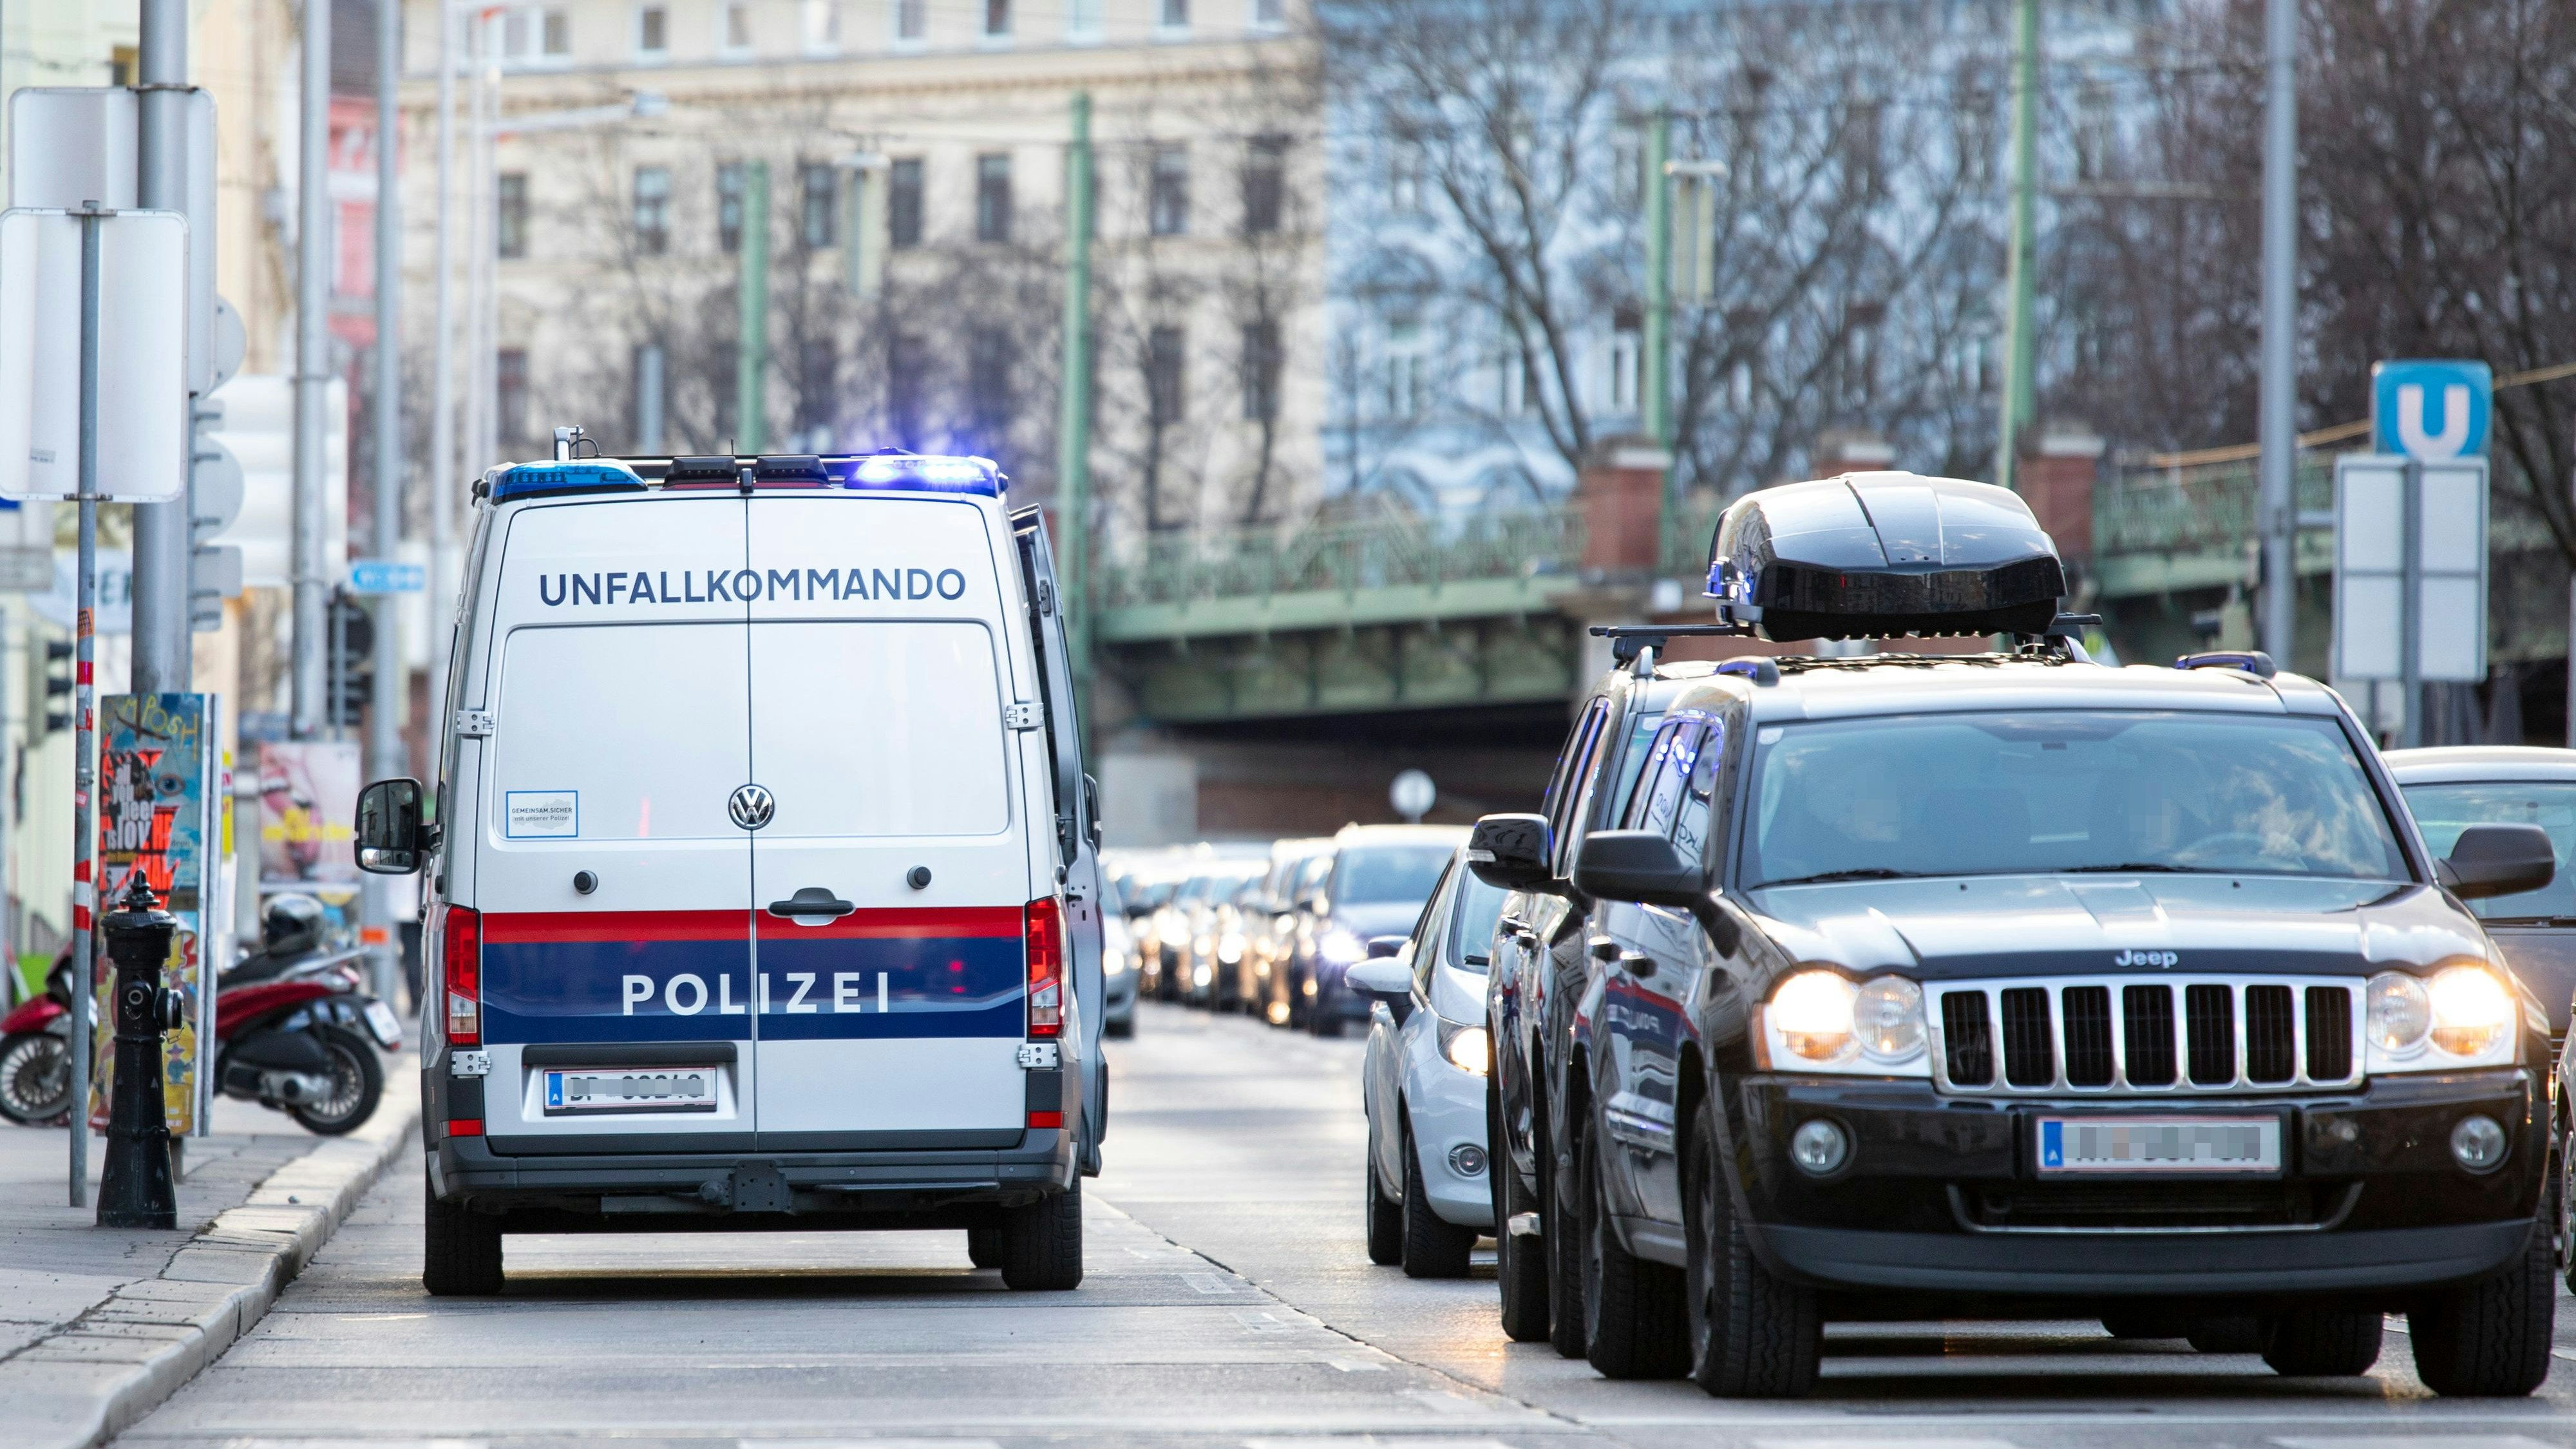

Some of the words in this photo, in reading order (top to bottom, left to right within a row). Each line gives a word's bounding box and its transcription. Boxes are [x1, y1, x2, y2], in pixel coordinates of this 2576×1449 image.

[2397, 384, 2470, 457] U
[540, 568, 966, 607] UNFALLKOMMANDO
[2114, 948, 2178, 969] Jeep
[623, 972, 889, 1016] POLIZEI
